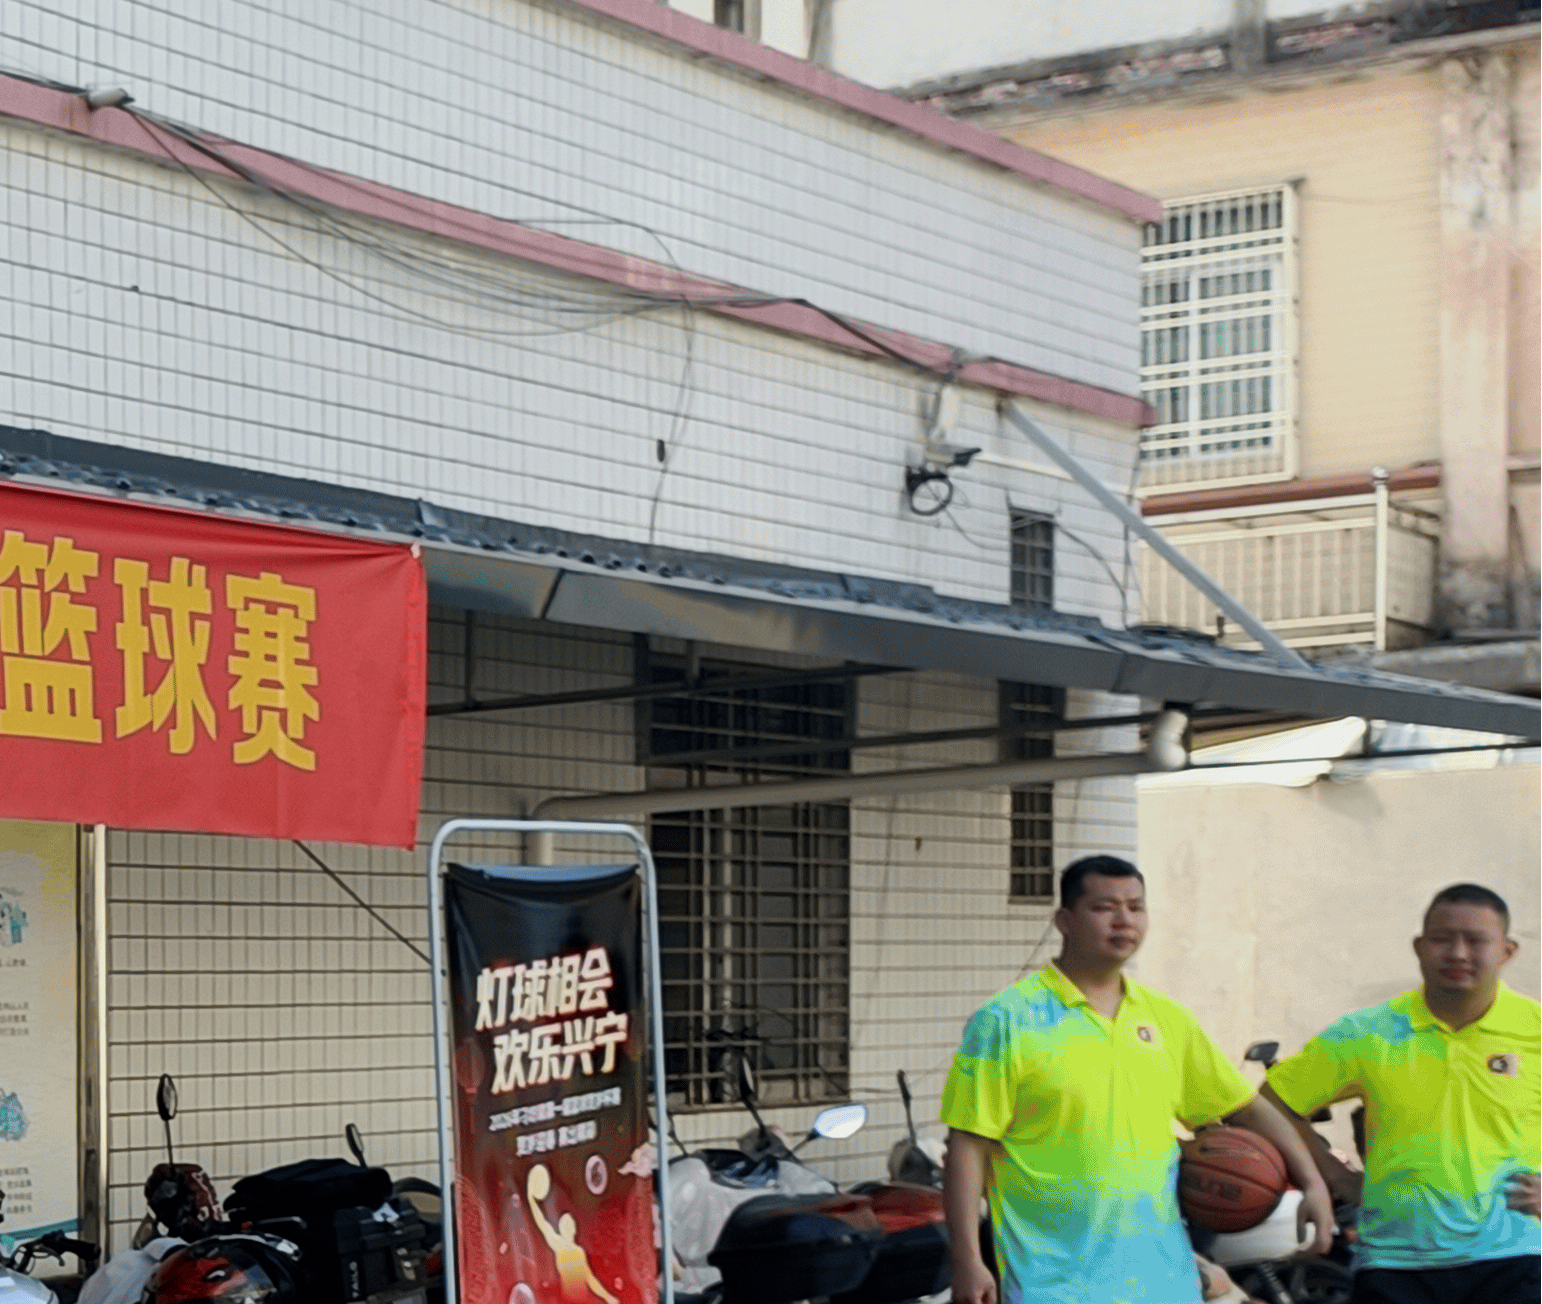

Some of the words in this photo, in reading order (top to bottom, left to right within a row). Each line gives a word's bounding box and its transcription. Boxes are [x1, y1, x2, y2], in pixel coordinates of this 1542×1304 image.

[475, 948, 614, 1031] 灯球相会
[491, 1011, 628, 1095] 欢乐兴宁
